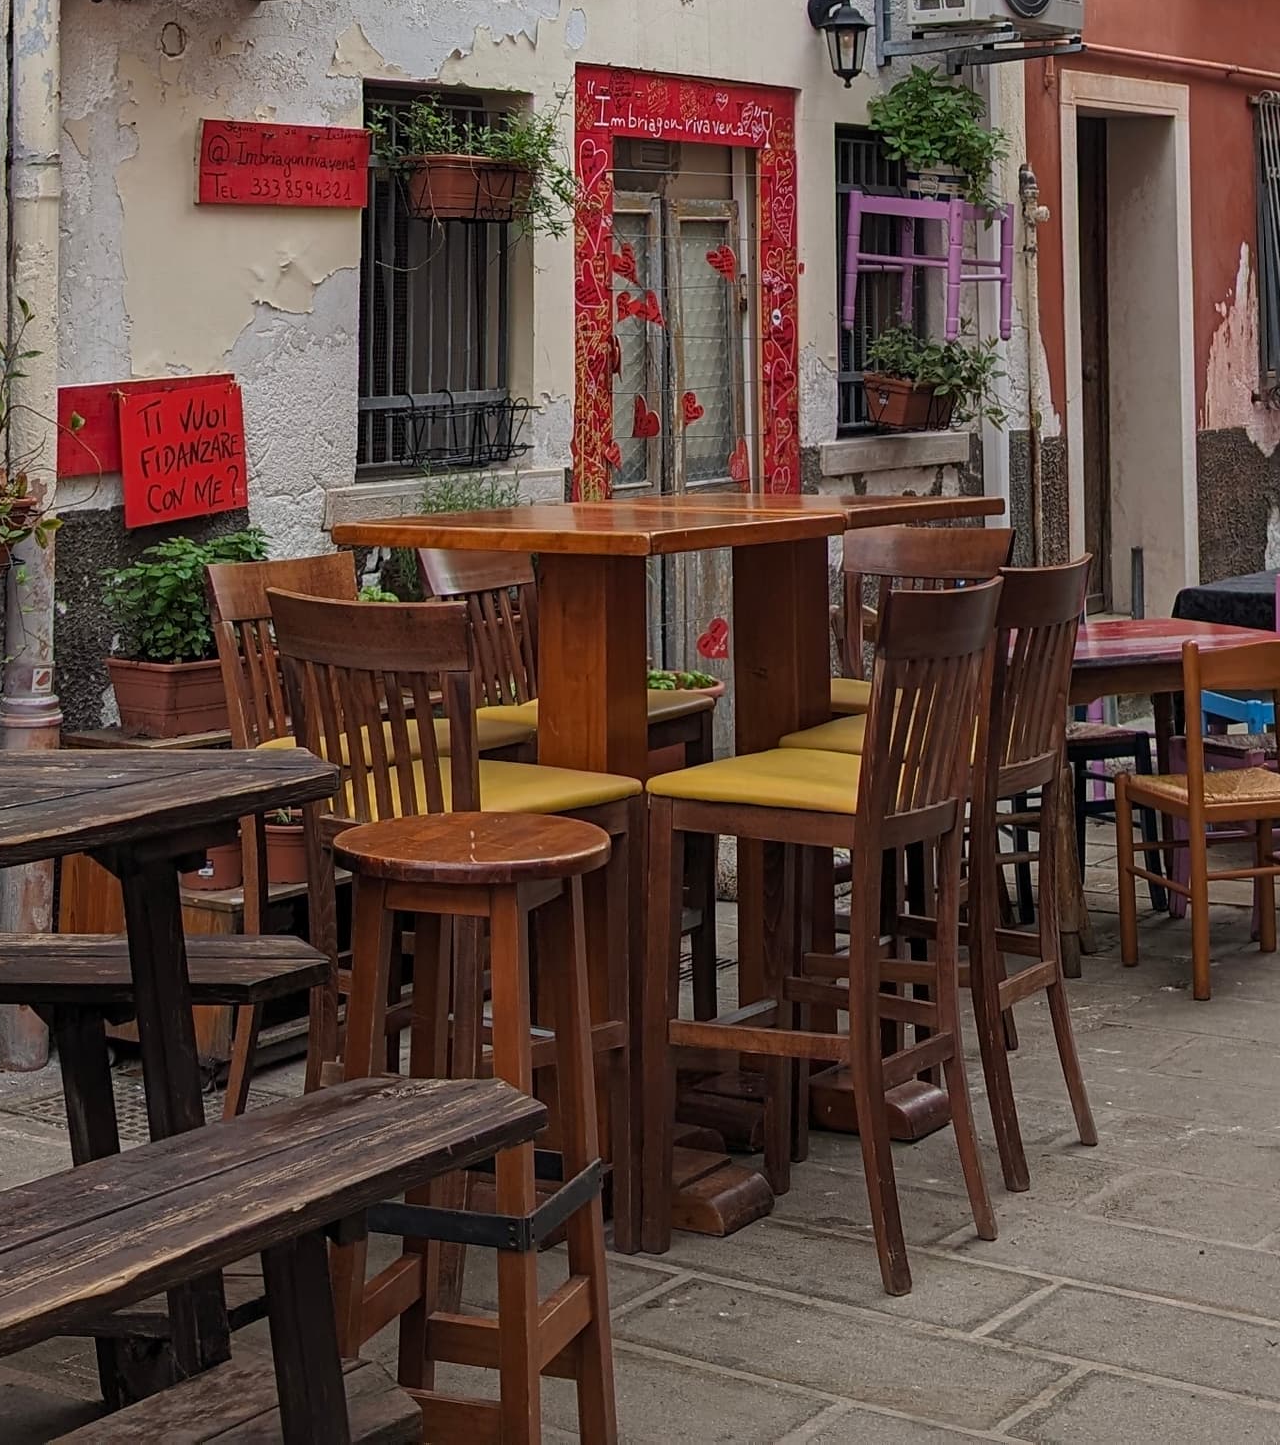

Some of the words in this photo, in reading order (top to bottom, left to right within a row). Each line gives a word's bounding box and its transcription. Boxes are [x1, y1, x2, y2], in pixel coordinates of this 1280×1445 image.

[136, 400, 162, 437] TI
[179, 398, 227, 434] VUOI
[140, 432, 242, 479] FIDANZARE
[147, 476, 186, 514] CON
